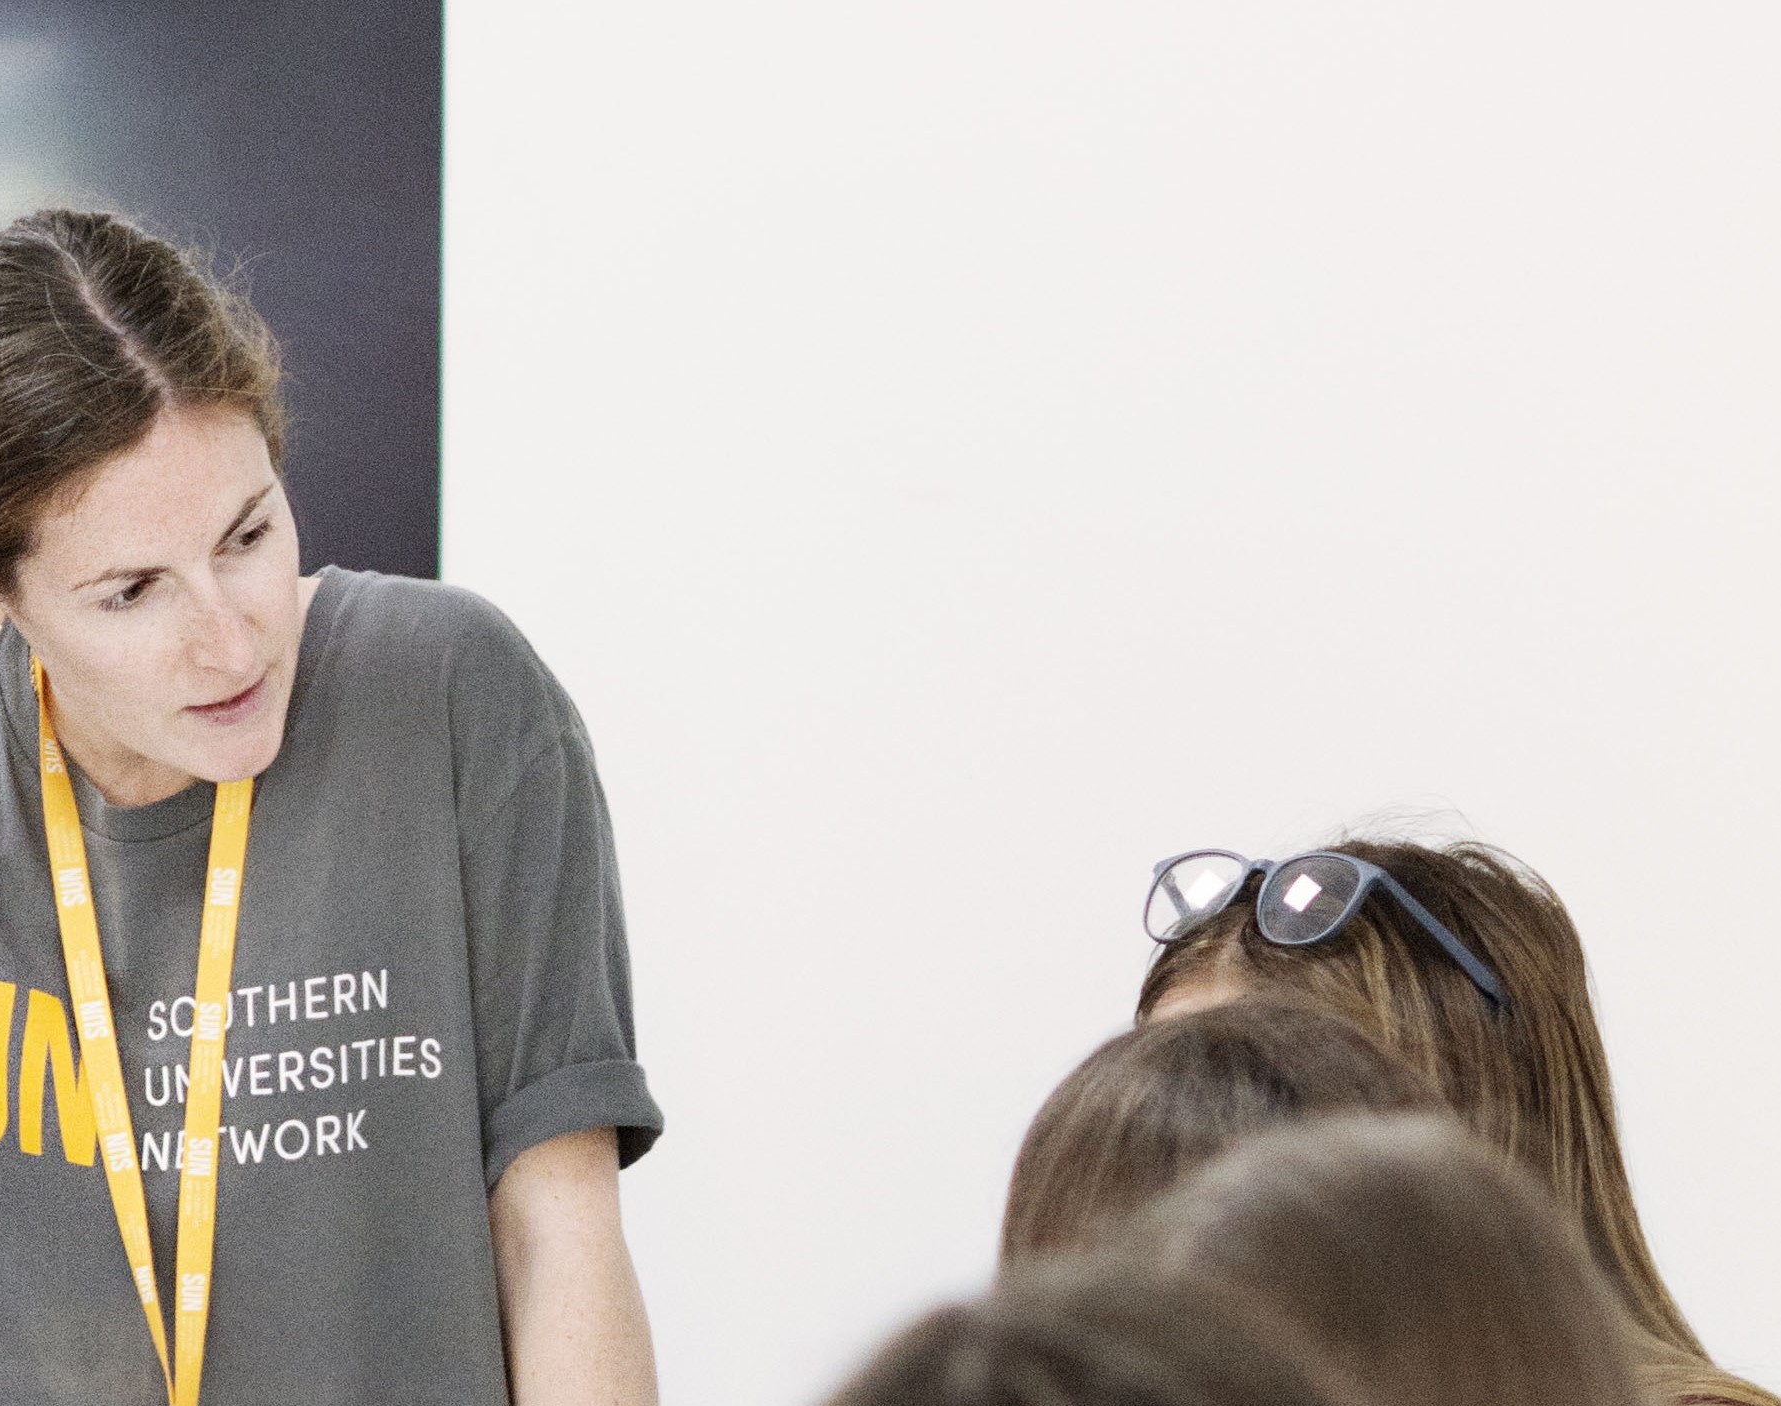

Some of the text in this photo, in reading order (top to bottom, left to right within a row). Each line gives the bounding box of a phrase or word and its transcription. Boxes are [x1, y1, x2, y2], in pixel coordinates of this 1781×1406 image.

[57, 867, 87, 907] SUN
[209, 867, 237, 906] SUN
[80, 1000, 110, 1041] SUN
[196, 1002, 222, 1040] SUN
[144, 1035, 443, 1107] UNVERSITIES
[104, 1132, 135, 1173] SUN
[187, 1137, 213, 1177] SUN
[180, 1272, 206, 1312] SUN
